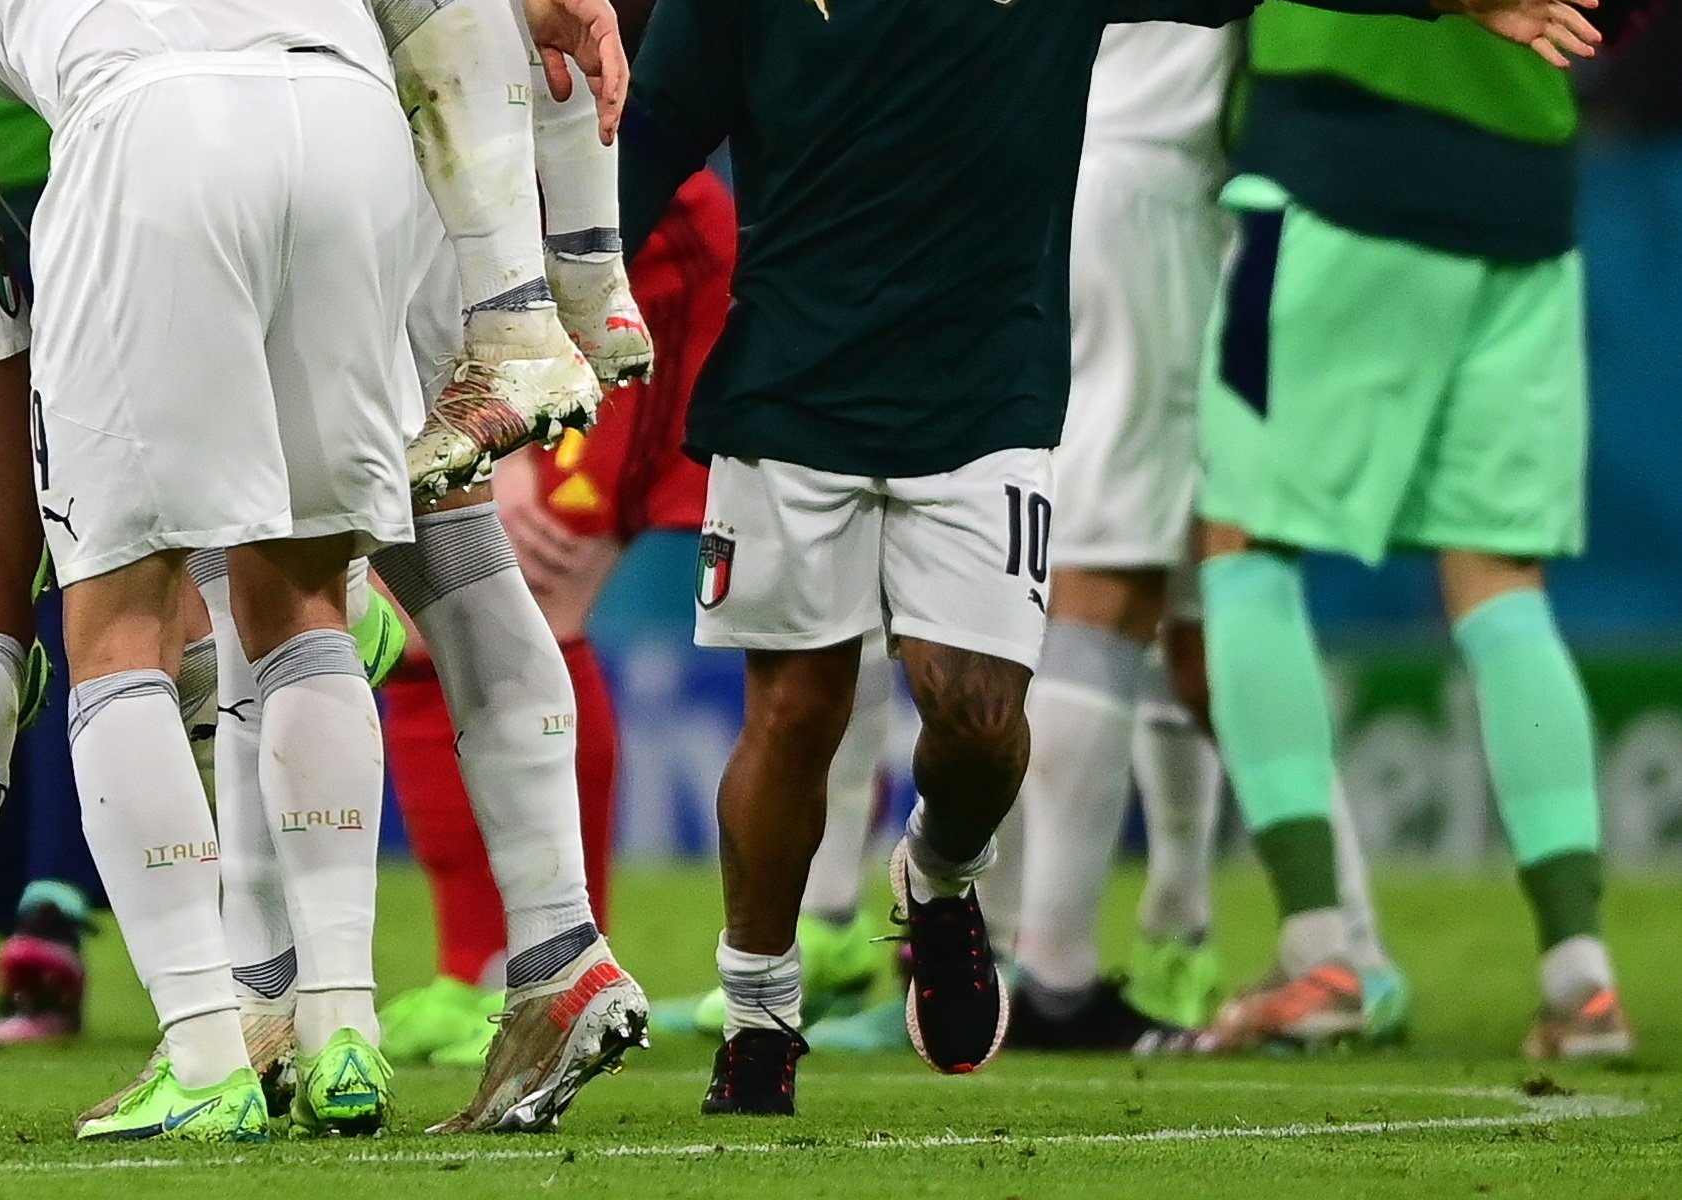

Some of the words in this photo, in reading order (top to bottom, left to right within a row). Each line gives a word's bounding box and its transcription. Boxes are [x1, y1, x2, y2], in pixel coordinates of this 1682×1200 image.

[1003, 483, 1052, 584] 10
[280, 808, 362, 828] ITALIA
[143, 840, 217, 865] ITALIA
